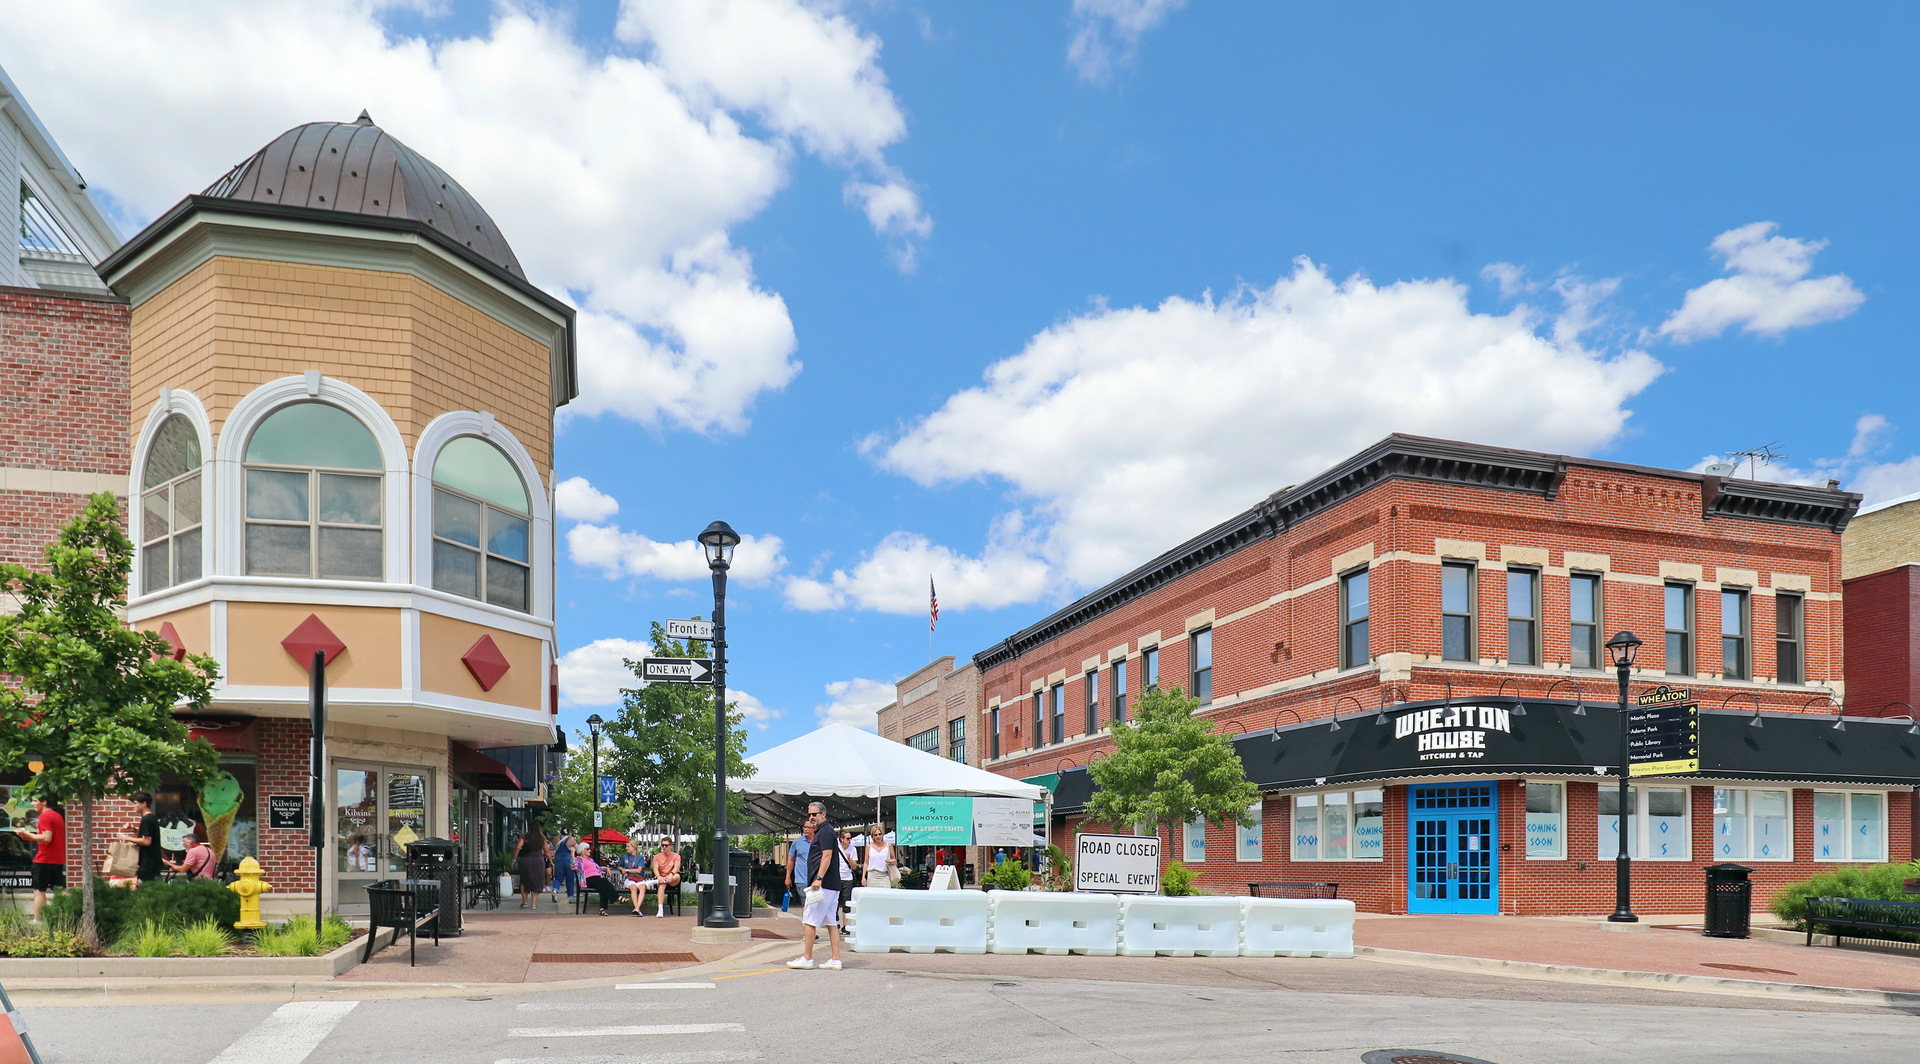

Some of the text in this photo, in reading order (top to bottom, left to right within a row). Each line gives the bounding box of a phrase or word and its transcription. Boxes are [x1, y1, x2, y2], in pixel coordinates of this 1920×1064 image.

[669, 622, 708, 635] Front St
[649, 665, 692, 674] ONE WAY
[1639, 691, 1687, 704] WHEATON
[1395, 706, 1511, 739] WHEATON
[1418, 730, 1486, 752] HOUSE
[1420, 752, 1457, 761] KITCHEN
[1467, 751, 1485, 759] TAP
[272, 799, 302, 807] Kilwins
[344, 808, 371, 817] Kilwins
[395, 811, 419, 819] Kilwins
[1356, 826, 1383, 836] COMING
[1526, 823, 1557, 833] COMING
[1246, 837, 1259, 847] ING
[1360, 840, 1380, 848] SOON
[1530, 837, 1553, 847] SOON
[1081, 841, 1157, 857] ROAD CLOSED
[1080, 872, 1155, 885] SPECIAL EVENT
